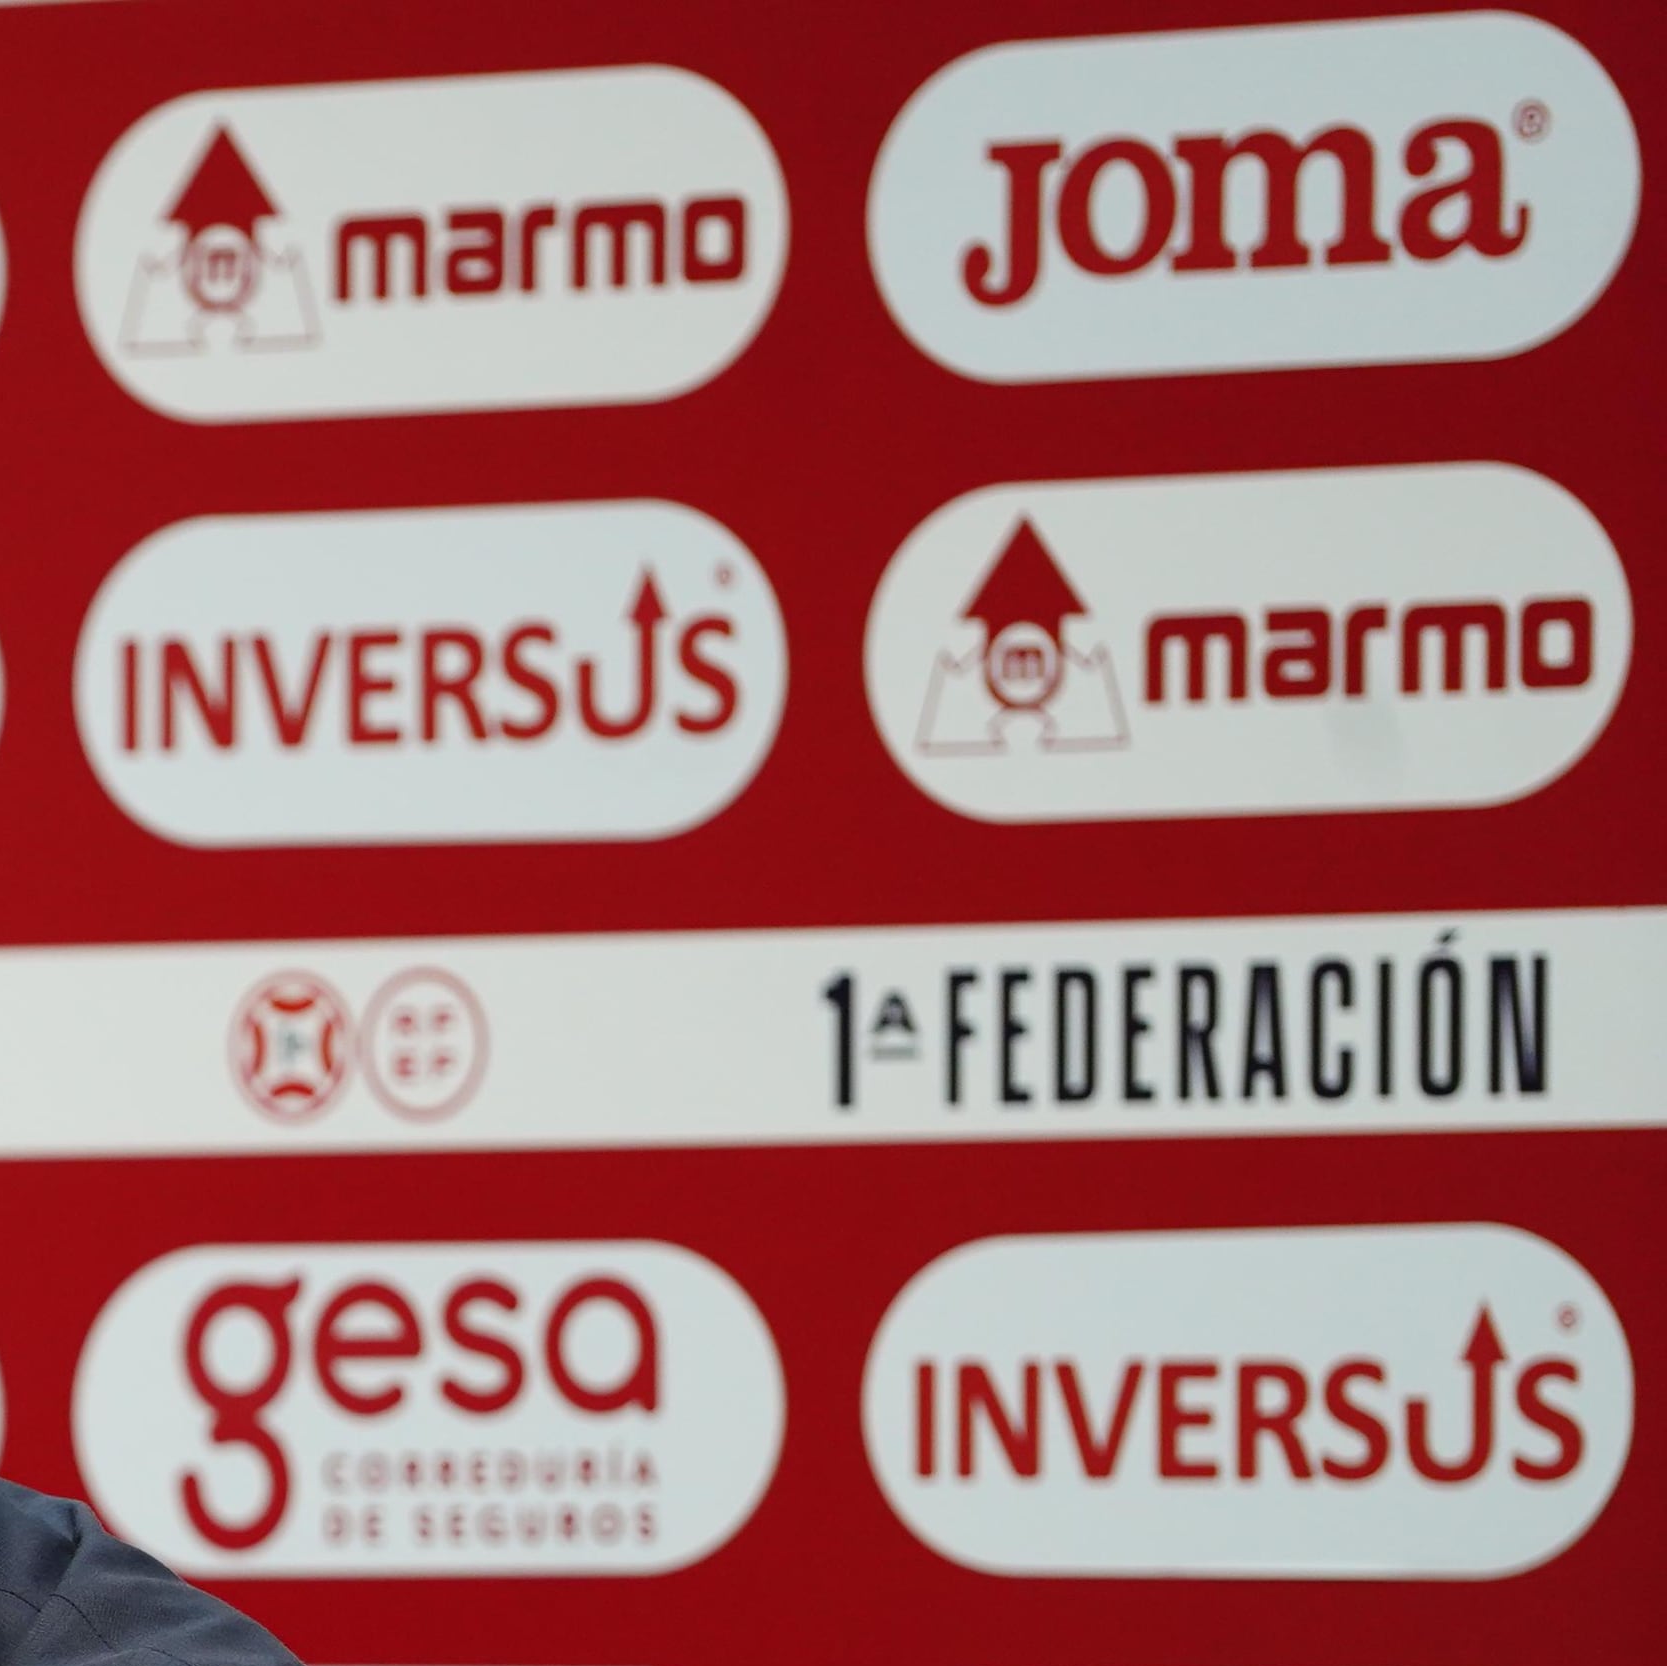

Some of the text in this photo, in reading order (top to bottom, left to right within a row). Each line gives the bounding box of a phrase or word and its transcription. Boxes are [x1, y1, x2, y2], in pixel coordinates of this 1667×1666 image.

[334, 193, 748, 305] marmo
[119, 562, 739, 754] INVERSUS
[1144, 594, 1595, 705] marmo
[943, 926, 1549, 1106] FEDERACIÓN
[179, 1274, 661, 1554] gesa
[913, 1300, 1587, 1486] INVERSUS
[321, 1502, 659, 1546] DE SEGUROS
[322, 1442, 659, 1494] CORREDURÍA
